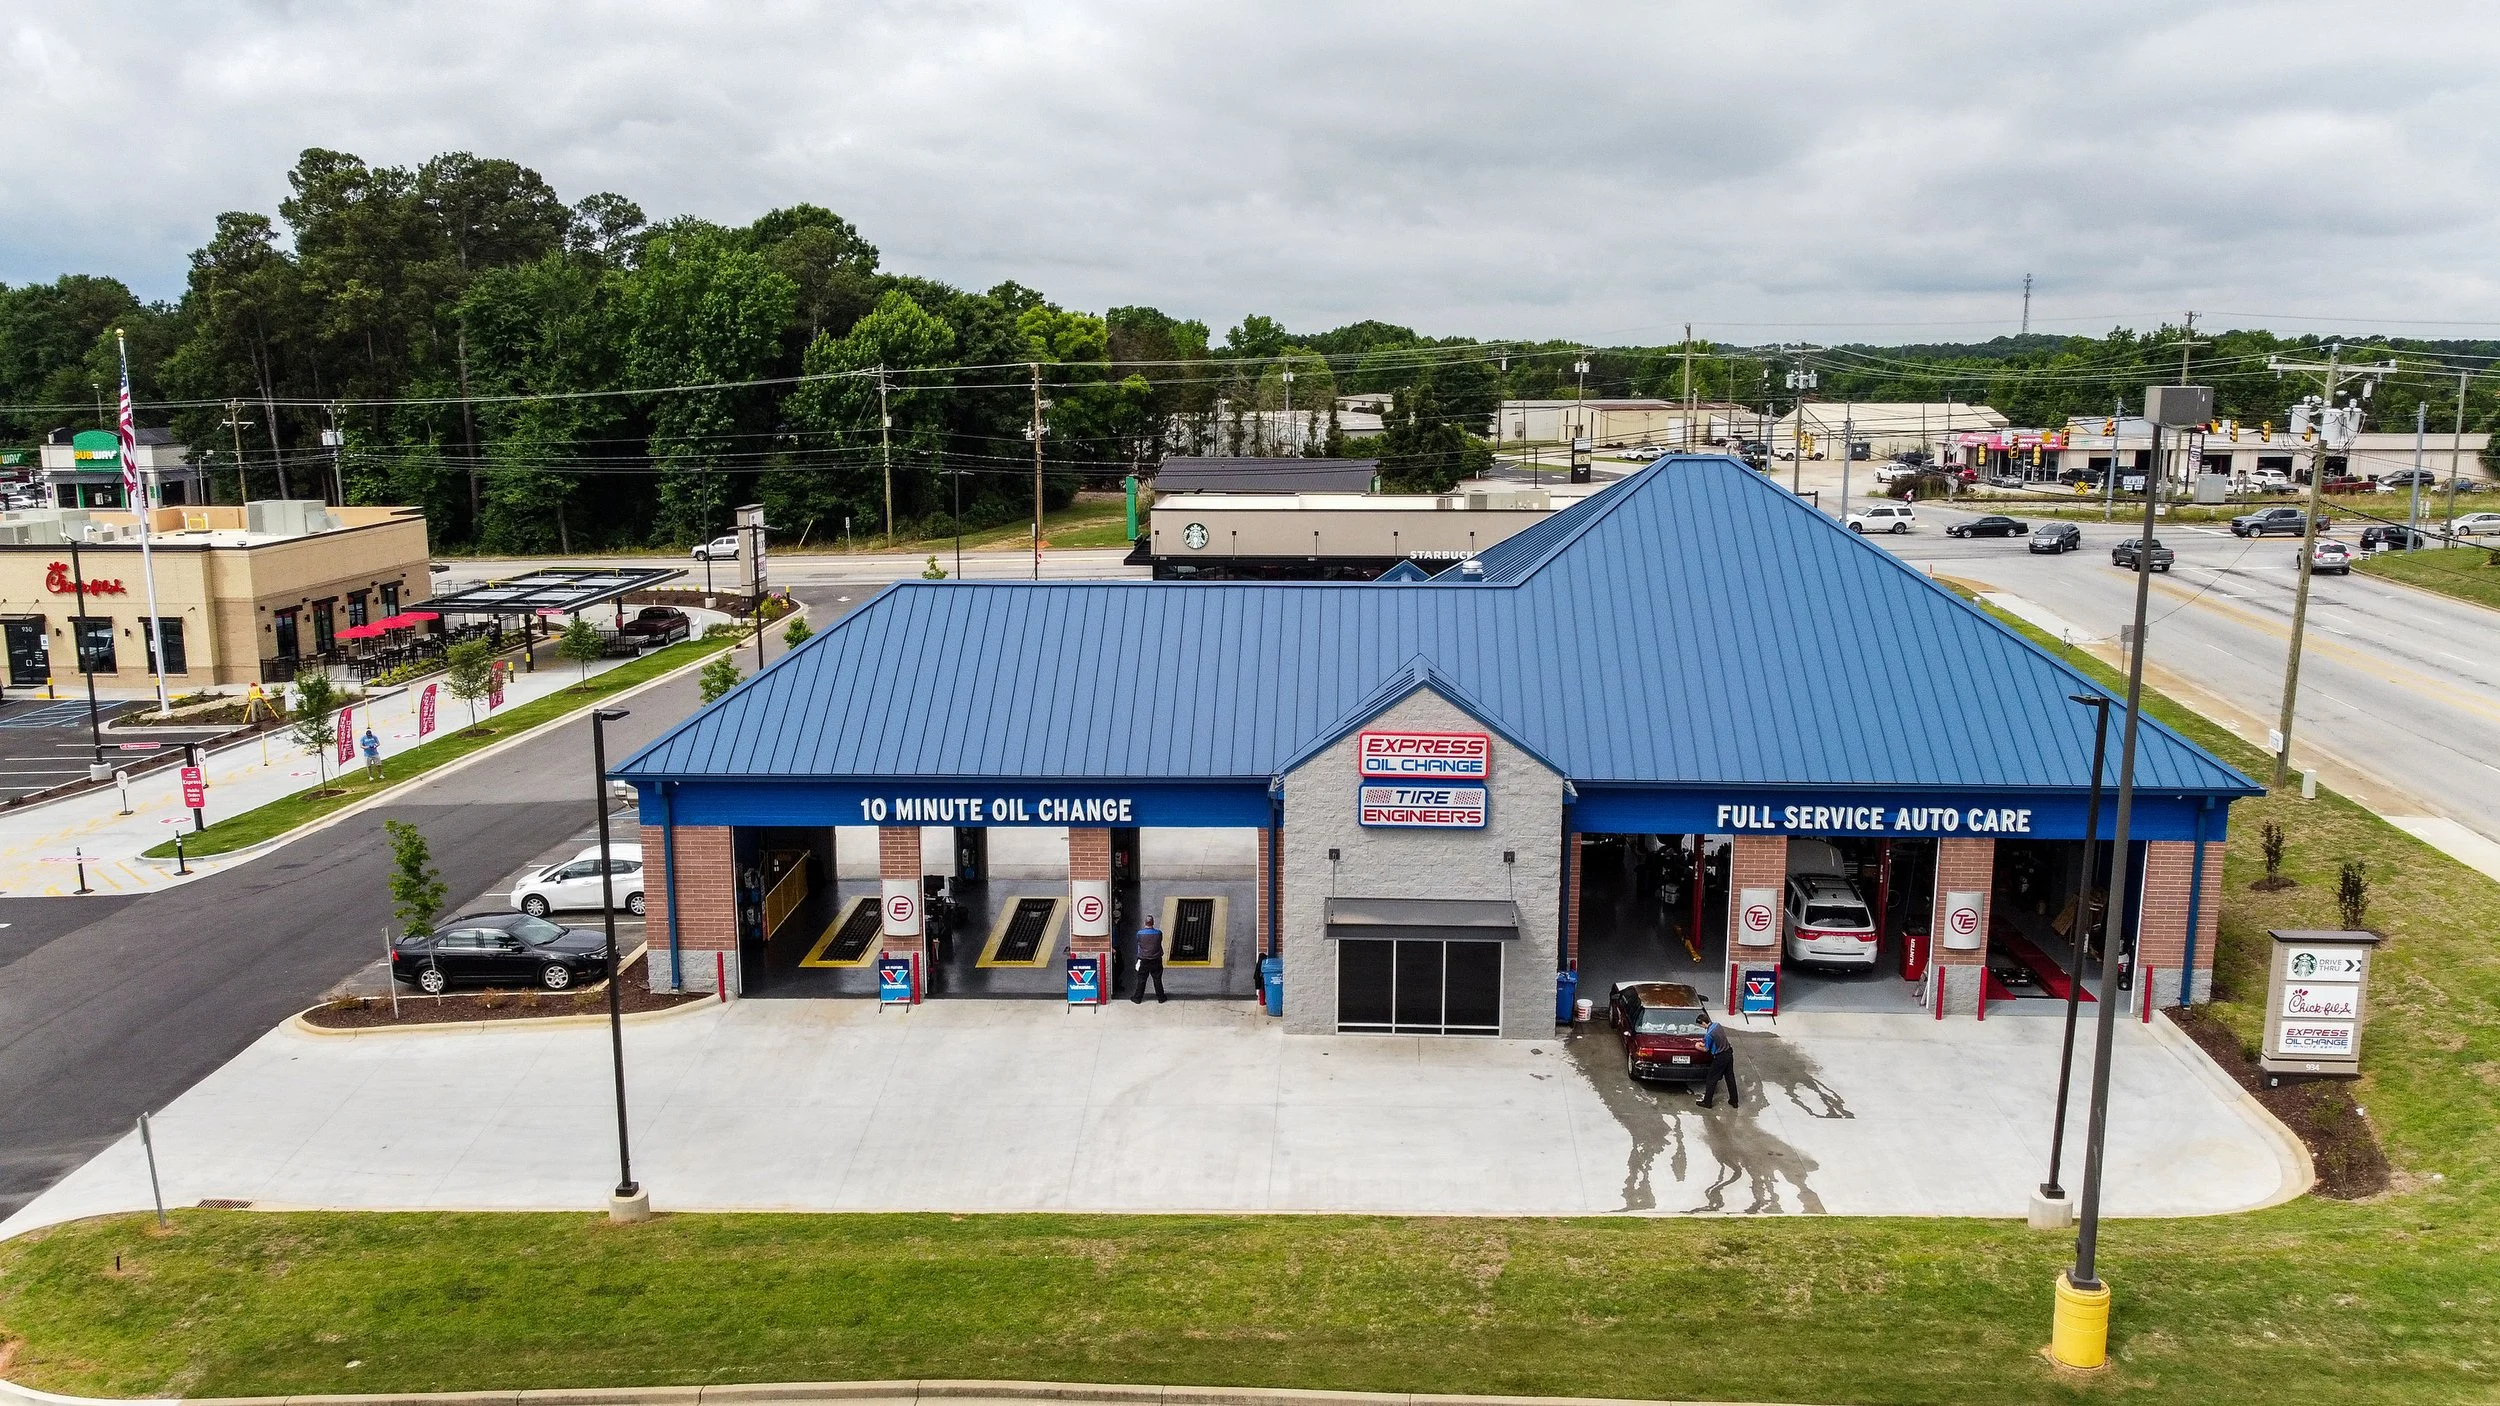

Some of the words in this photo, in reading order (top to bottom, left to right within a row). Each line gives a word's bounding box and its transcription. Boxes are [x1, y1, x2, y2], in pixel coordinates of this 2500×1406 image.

[74, 450, 118, 460] SUBWAY
[1366, 738, 1485, 754] EXPRESS
[1366, 758, 1397, 771] OIL
[1401, 759, 1483, 773] CHANGE
[1395, 790, 1451, 804] TIRE
[860, 798, 887, 821] 10
[895, 798, 984, 821] MINUTE
[991, 798, 1030, 821] OIL
[1038, 798, 1132, 822] CHANGE
[1363, 809, 1481, 824] ENGINEERS
[1717, 804, 1776, 829] FULL
[1783, 806, 1884, 830] SERVICE
[1893, 807, 1959, 831] AUTO
[1966, 808, 2031, 833] CARE
[893, 902, 909, 915] E
[1083, 902, 1099, 915] E
[1749, 911, 1769, 926] TE
[1955, 913, 1976, 929] TE
[2289, 990, 2352, 1016] Chick-fil-A
[2286, 1028, 2349, 1037] EXPRESS
[2305, 1063, 2320, 1071] 934
